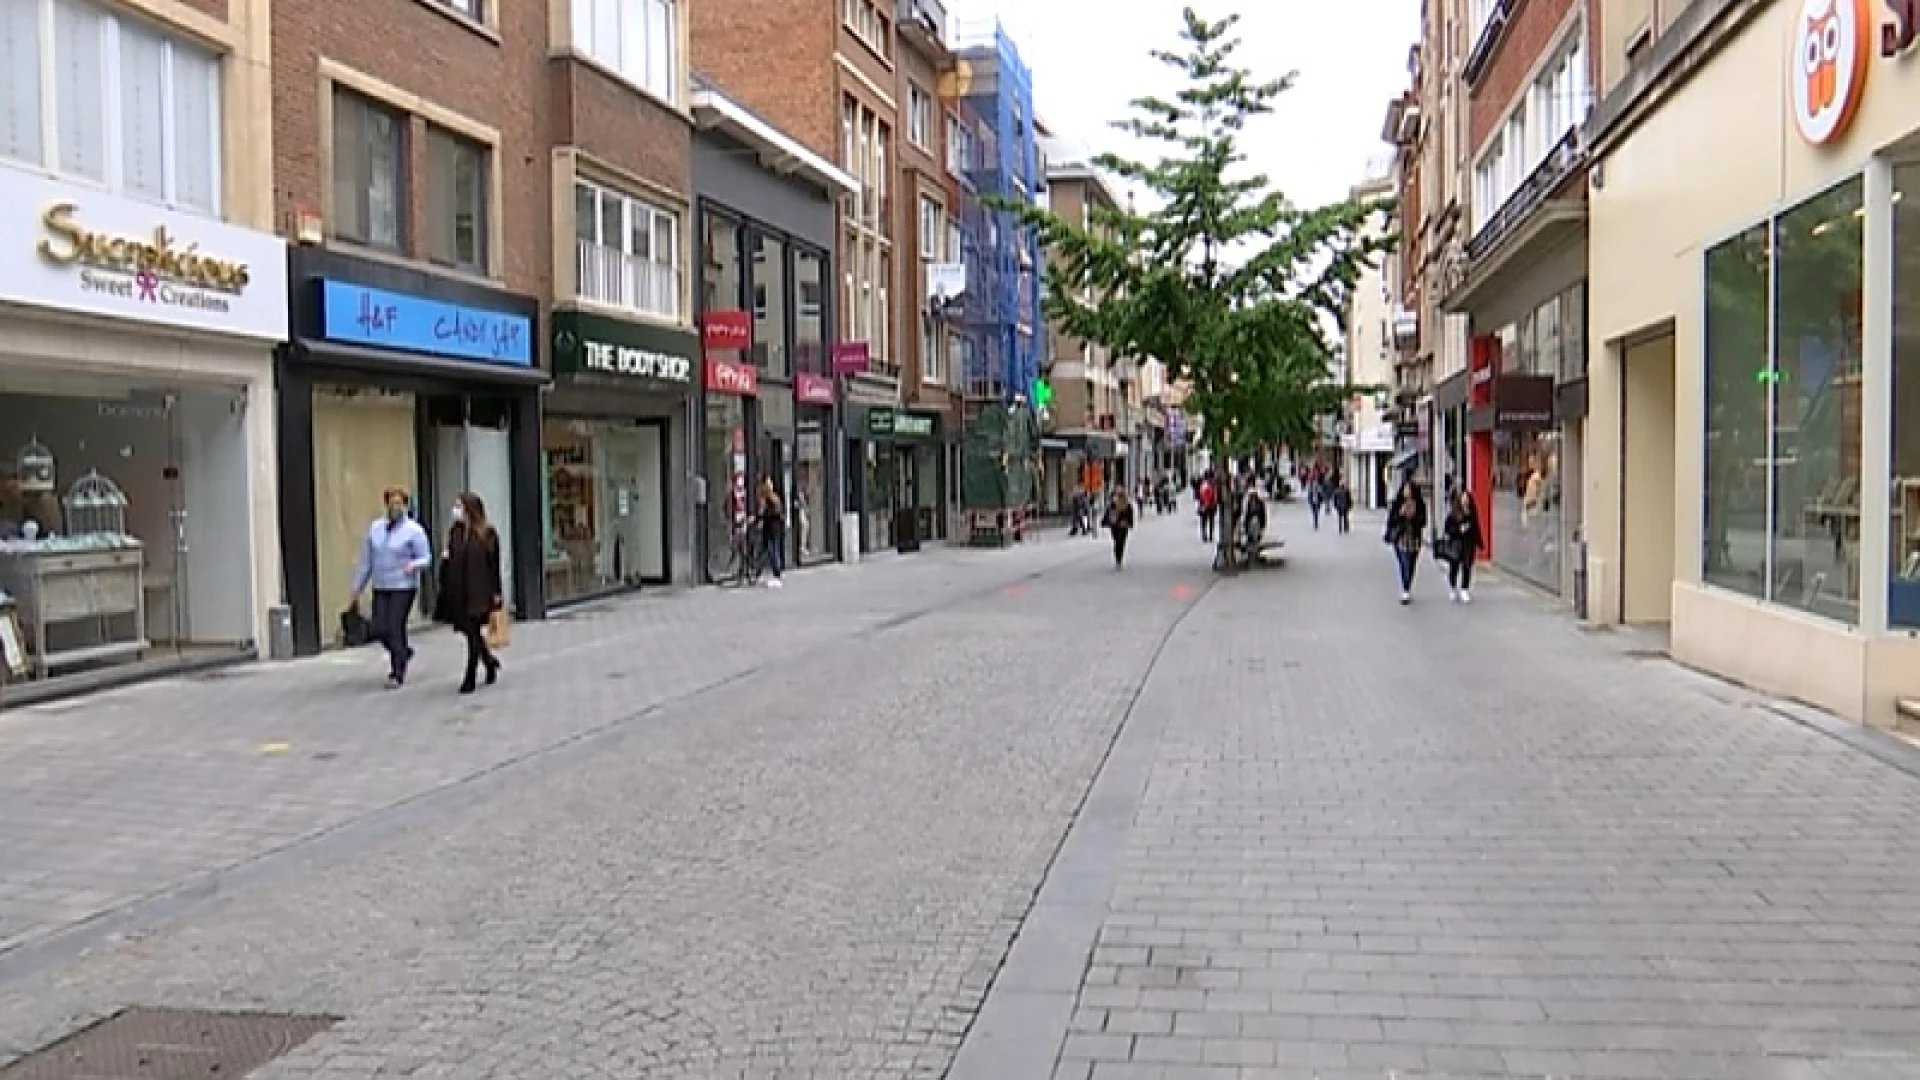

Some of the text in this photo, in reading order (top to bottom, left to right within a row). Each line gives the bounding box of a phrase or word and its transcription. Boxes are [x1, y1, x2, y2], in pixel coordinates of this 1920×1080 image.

[79, 269, 229, 312] Sweet Creations
[357, 292, 397, 336] H&F
[583, 341, 615, 372] THE
[617, 345, 656, 377] BODY
[656, 352, 690, 382] SHOP
